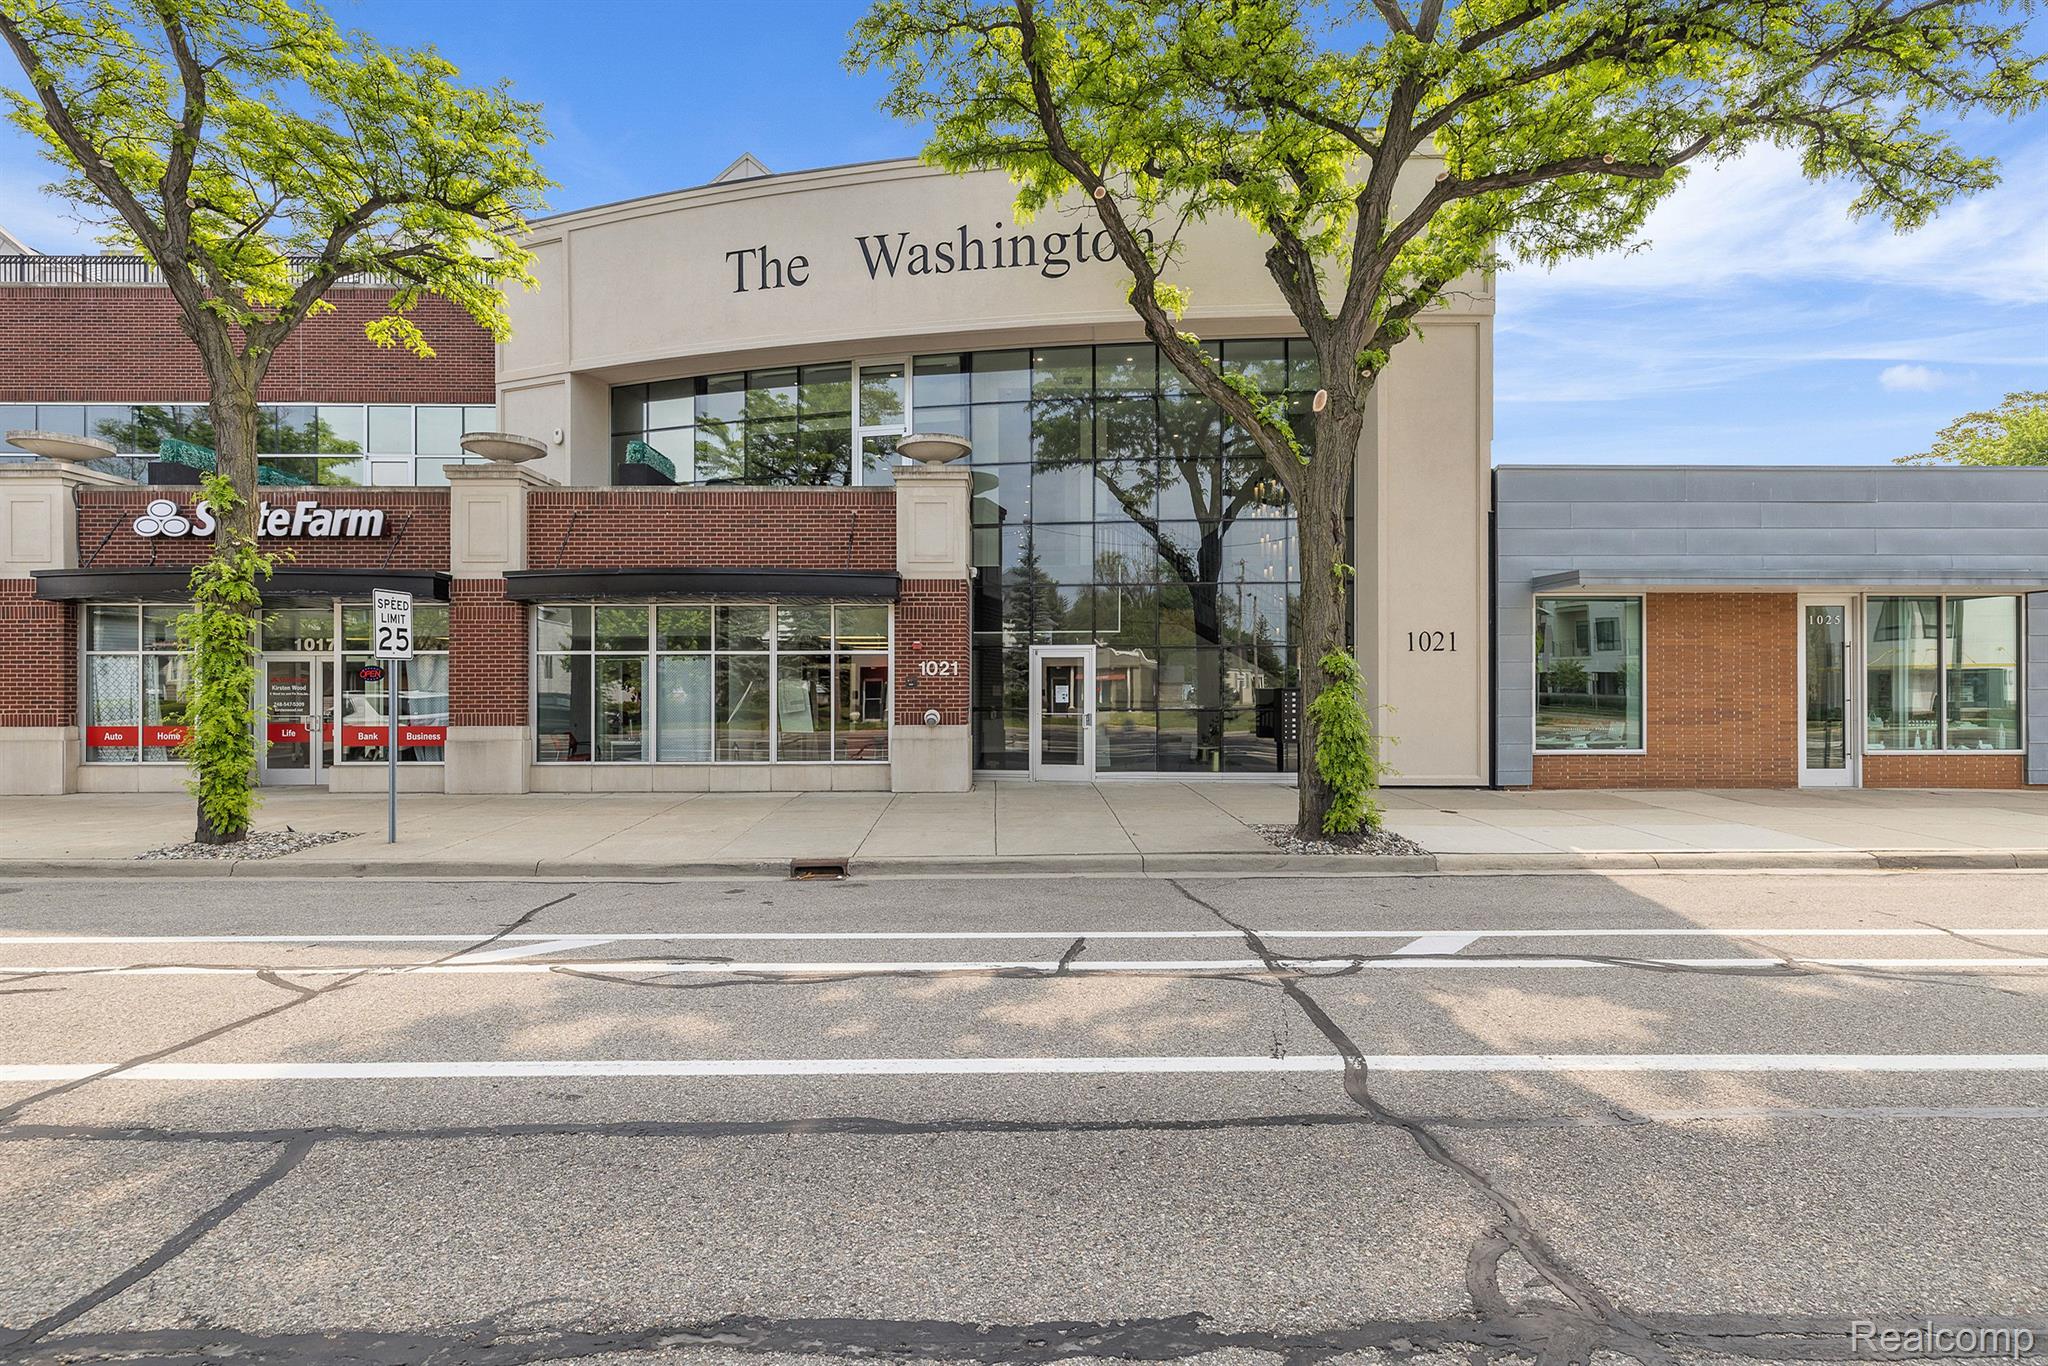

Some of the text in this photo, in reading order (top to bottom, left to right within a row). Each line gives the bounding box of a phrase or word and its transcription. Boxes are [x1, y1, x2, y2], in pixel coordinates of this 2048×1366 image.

[726, 245, 810, 294] The
[192, 501, 384, 537] SteFarm
[377, 598, 409, 611] SPEED
[381, 613, 405, 625] LIMIT
[1809, 615, 1841, 625] 1025
[294, 638, 334, 651] 1017
[378, 627, 409, 651] 25
[1407, 631, 1457, 652] 1021
[360, 669, 381, 679] OPEN
[918, 660, 958, 676] 1021
[104, 732, 123, 741] Auto
[157, 732, 181, 741] Home
[281, 729, 296, 738] Life
[358, 732, 379, 741] Bank
[406, 732, 441, 741] Business
